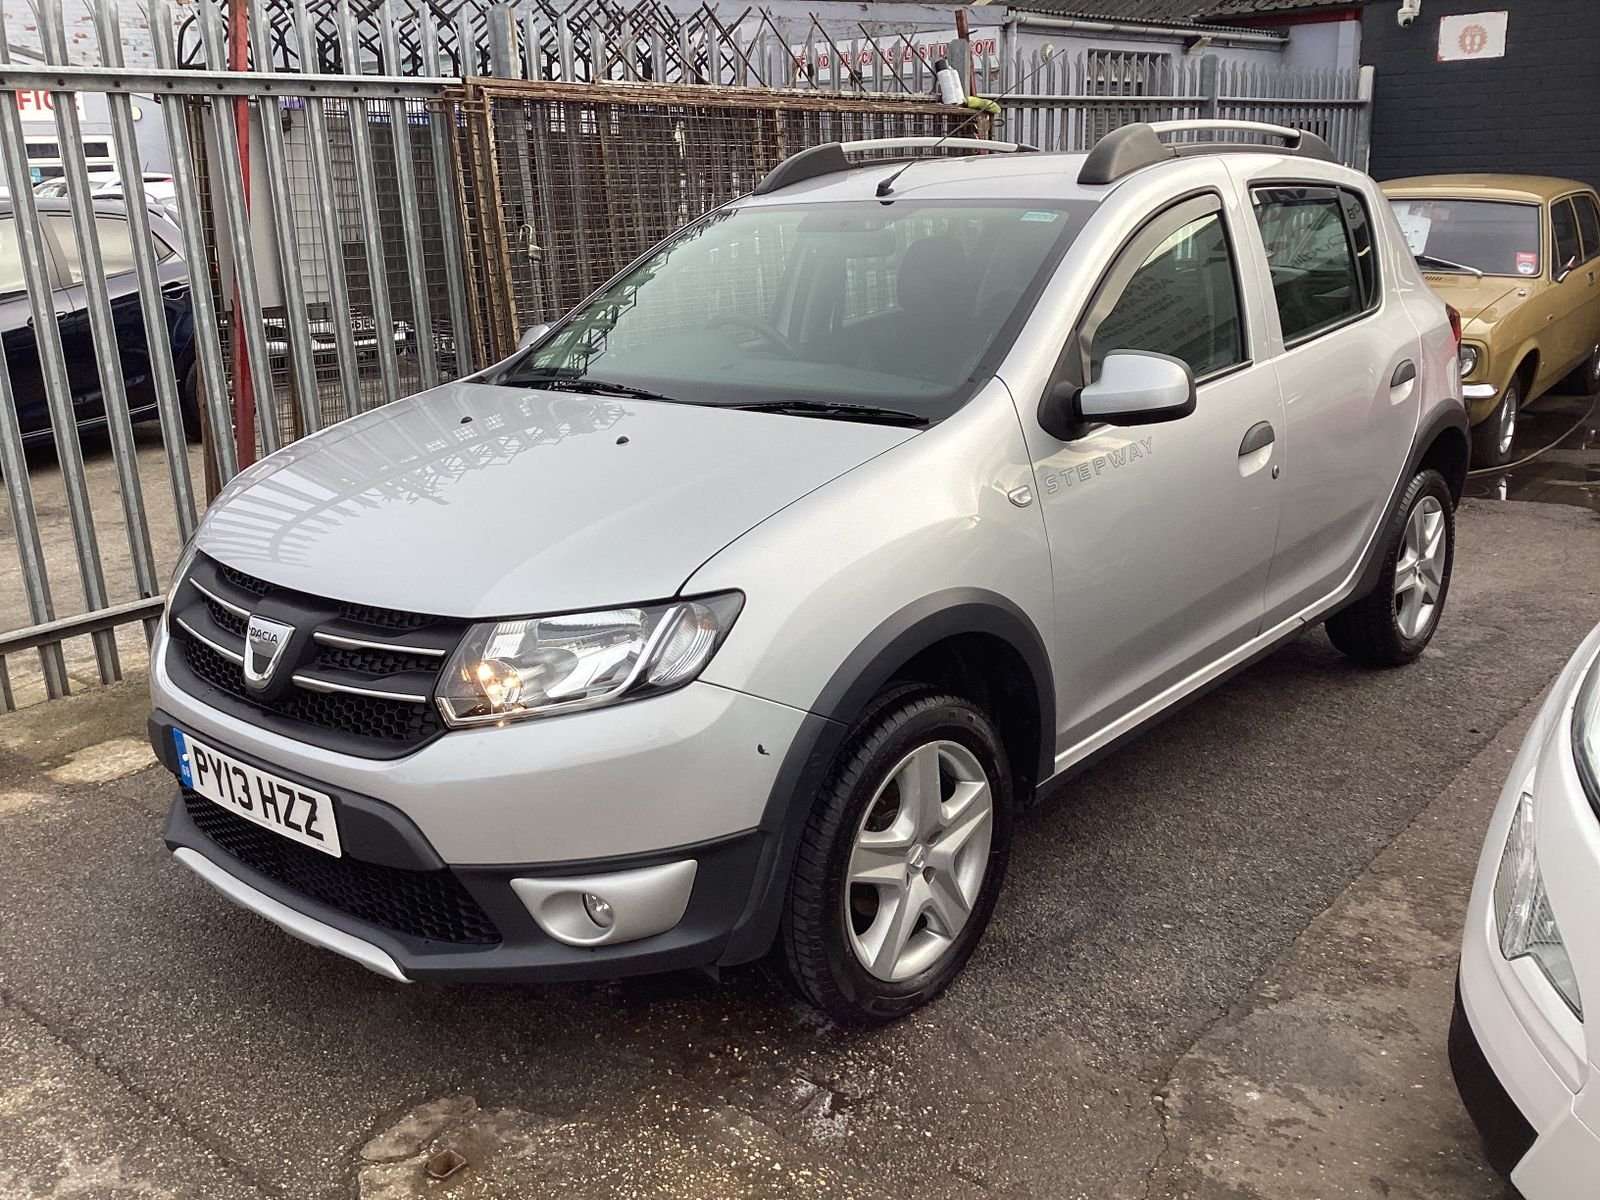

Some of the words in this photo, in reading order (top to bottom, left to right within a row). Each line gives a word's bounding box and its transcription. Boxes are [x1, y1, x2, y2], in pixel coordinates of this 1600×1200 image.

[1045, 437, 1153, 494] STEPWAY
[250, 626, 278, 644] DACIA
[192, 745, 253, 811] PY13
[256, 775, 325, 841] HZZ
